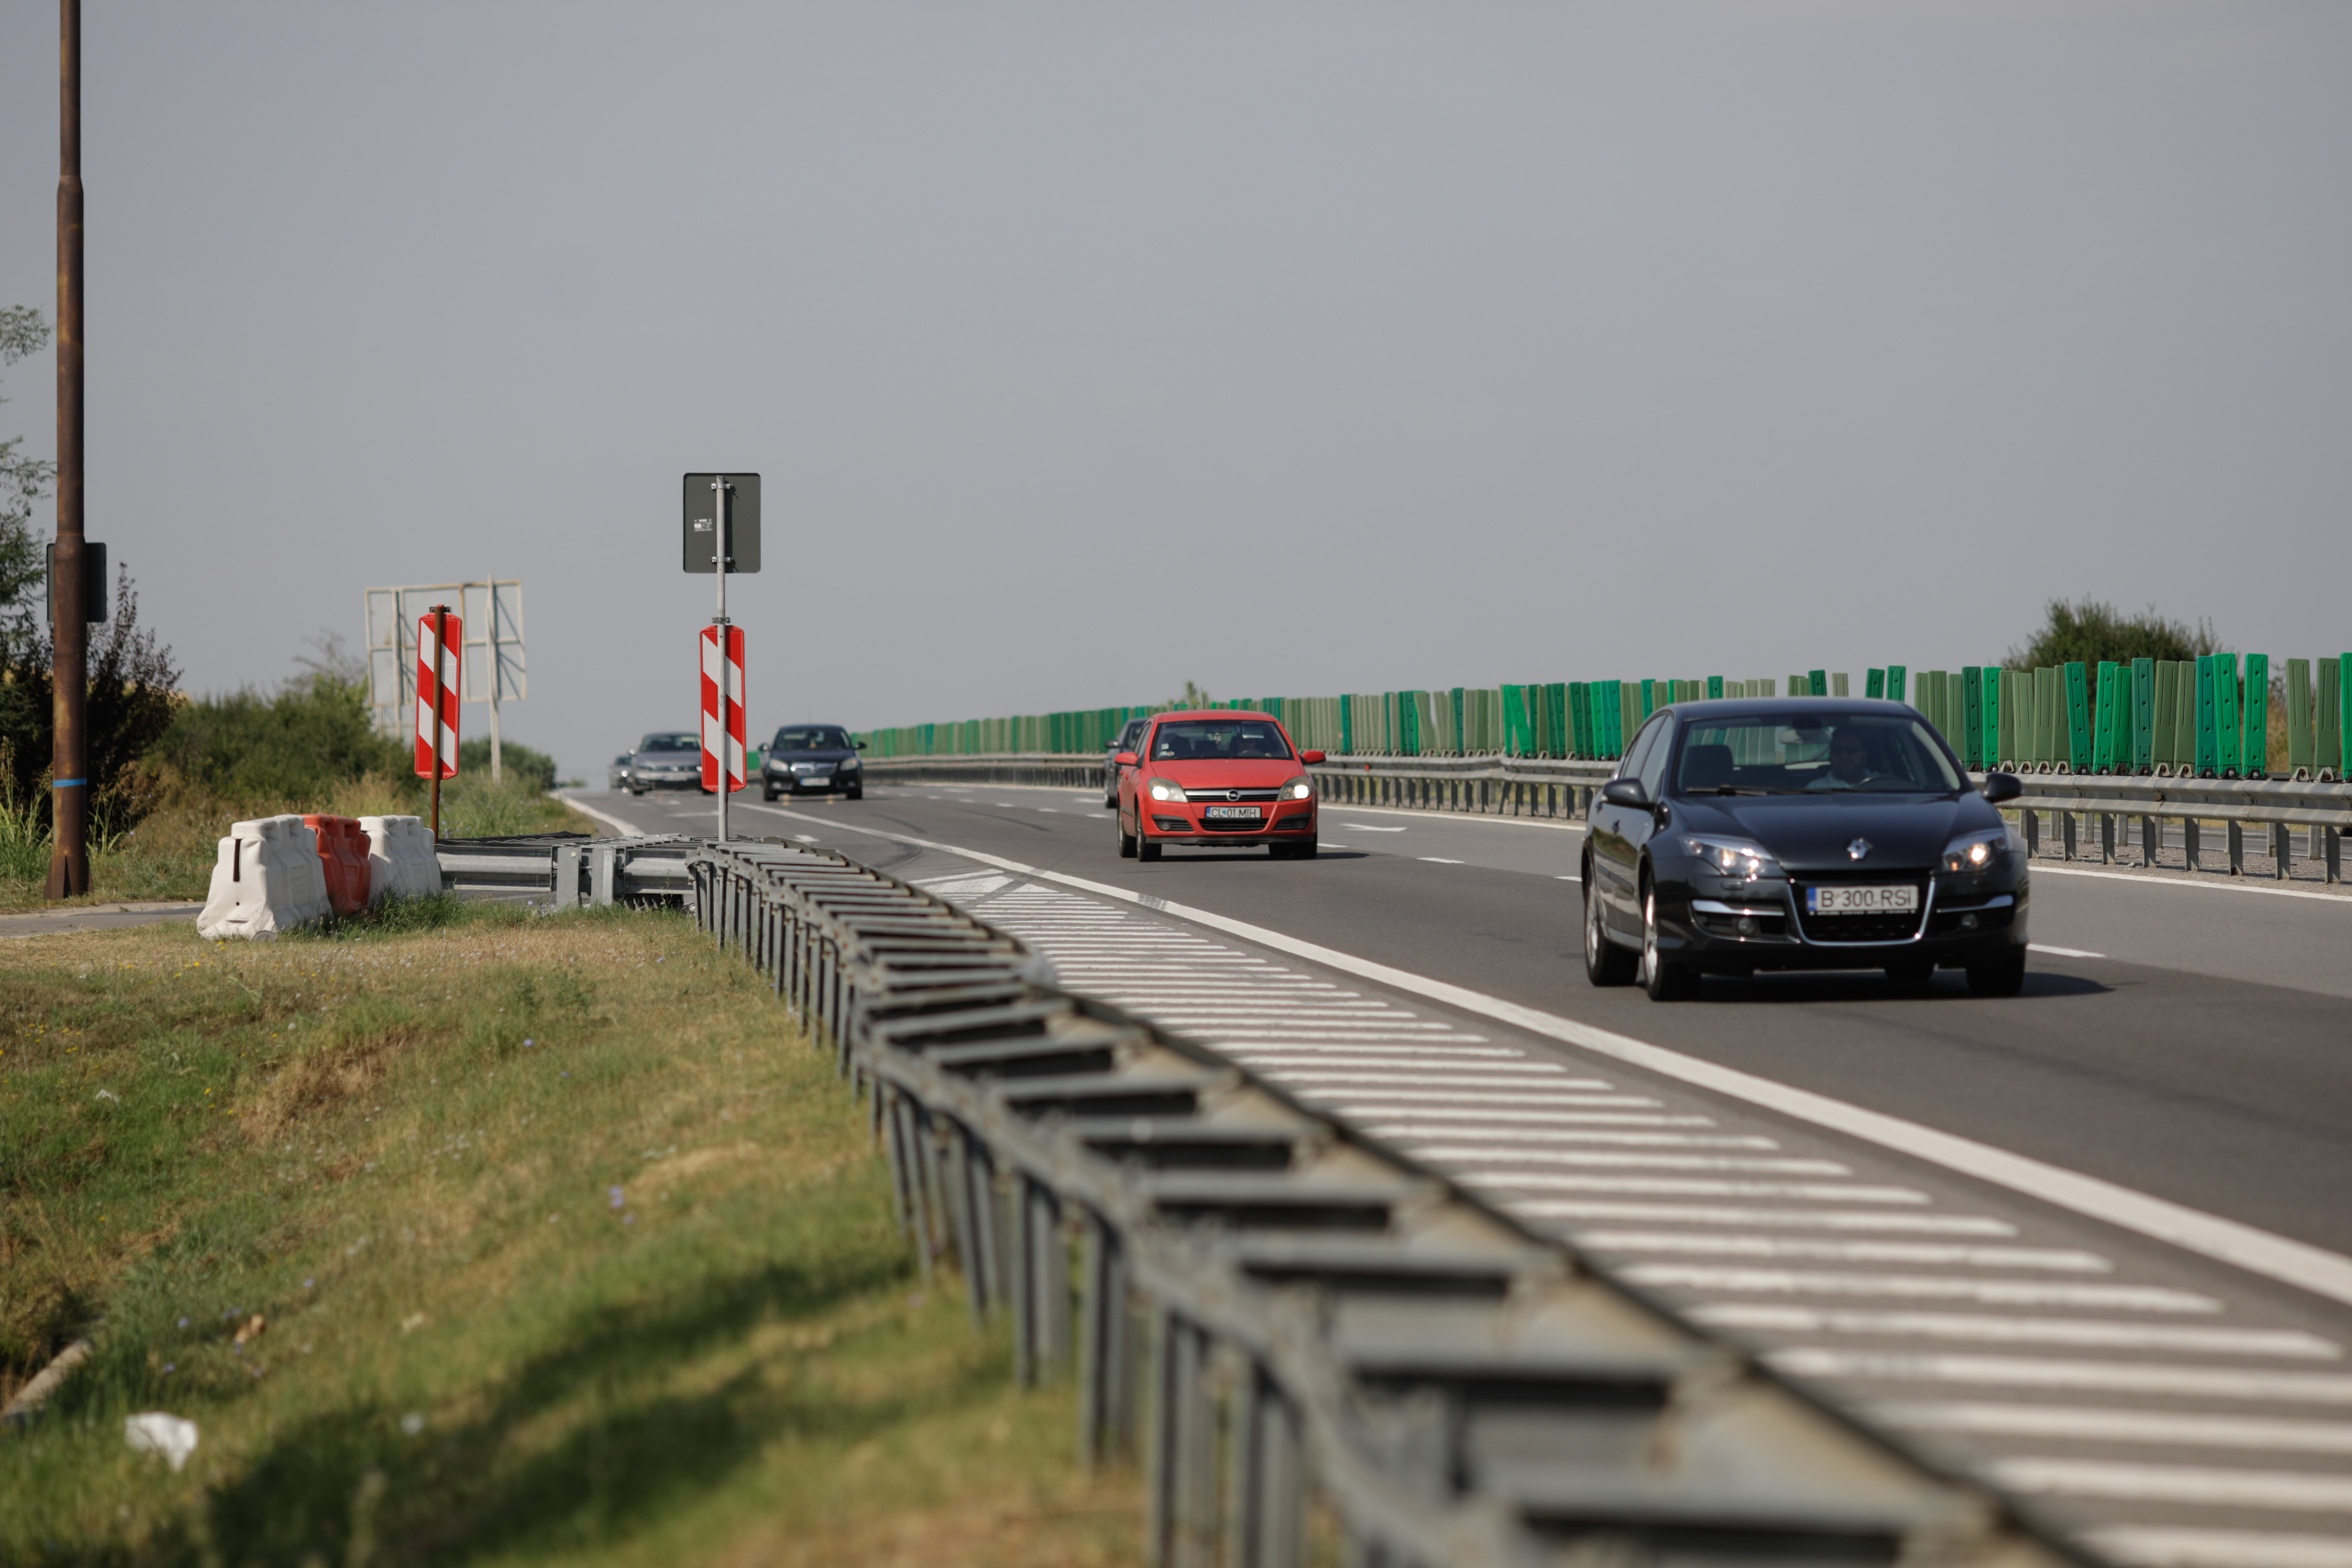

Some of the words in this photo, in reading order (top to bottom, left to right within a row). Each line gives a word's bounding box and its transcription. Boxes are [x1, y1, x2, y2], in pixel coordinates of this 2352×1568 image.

[1212, 808, 1223, 817] CL
[1227, 808, 1236, 817] 01
[1239, 808, 1256, 818] MIH
[1821, 890, 1834, 907] B
[1842, 890, 1874, 907] 300
[1881, 889, 1911, 906] RSI
